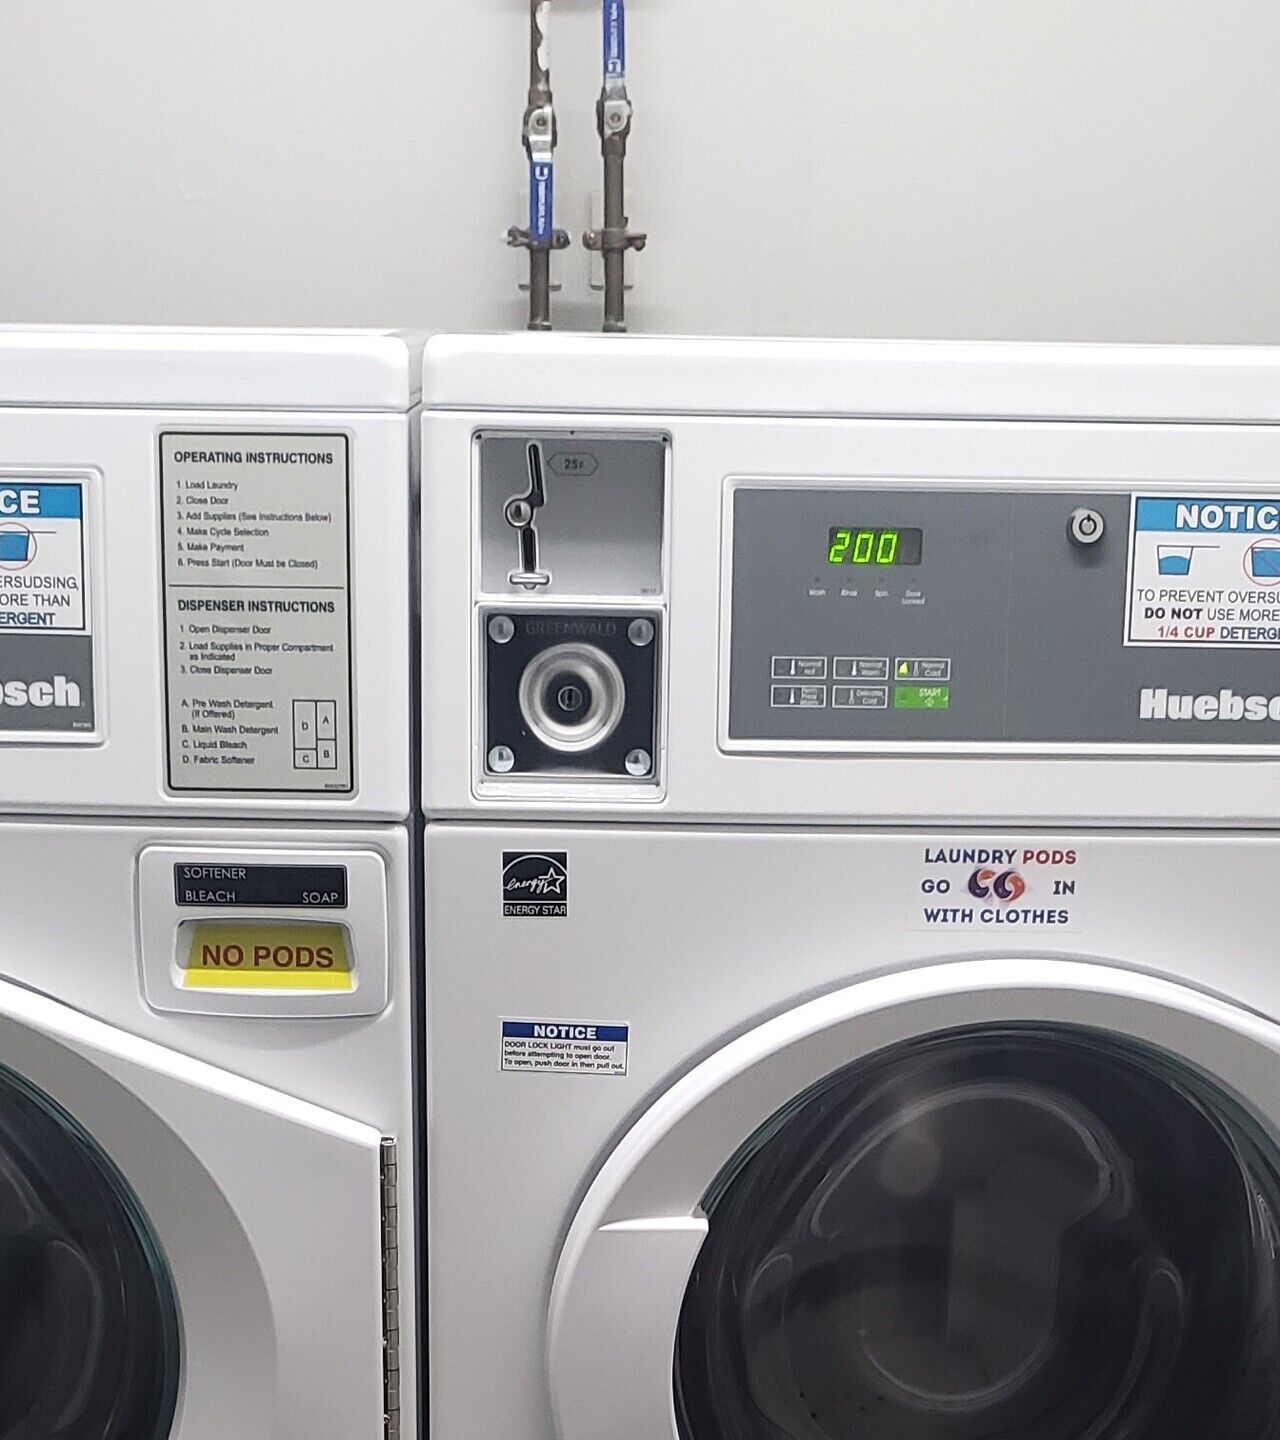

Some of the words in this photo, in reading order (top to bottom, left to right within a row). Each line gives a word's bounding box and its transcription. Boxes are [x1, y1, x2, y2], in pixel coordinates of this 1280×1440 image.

[174, 451, 242, 463] OPERATING
[246, 452, 333, 464] INSTRUCTIONS
[828, 532, 898, 563] 200
[33, 594, 70, 607] THAN
[1137, 589, 1155, 601] TO
[1159, 590, 1223, 603] PREVENT
[178, 600, 244, 612] DISPENSER
[248, 601, 335, 613] INSTRUCTIONS
[1144, 607, 1165, 619] DO
[1171, 608, 1203, 620] NOT
[1207, 608, 1234, 621] USE
[1239, 609, 1280, 622] MORE
[1157, 626, 1178, 638] 1/4
[1184, 627, 1215, 639] CUP
[323, 716, 329, 724] A
[303, 755, 309, 763] C
[324, 750, 329, 758] B
[925, 849, 1017, 864] LAUNDRY
[1023, 850, 1076, 865] PODS
[184, 867, 246, 879] SOFTENER
[921, 879, 950, 894] GO
[1053, 880, 1075, 895] IN
[185, 890, 236, 902] BLEACH
[302, 891, 338, 904] SOAP
[505, 905, 541, 915] ENERGY
[543, 905, 567, 915] STAR
[924, 908, 973, 923] WITH
[980, 909, 1069, 924] CLOTHES
[202, 944, 244, 967] NO
[254, 946, 334, 968] PODS
[534, 1025, 597, 1039] NOTICE
[528, 1051, 564, 1059] attempting
